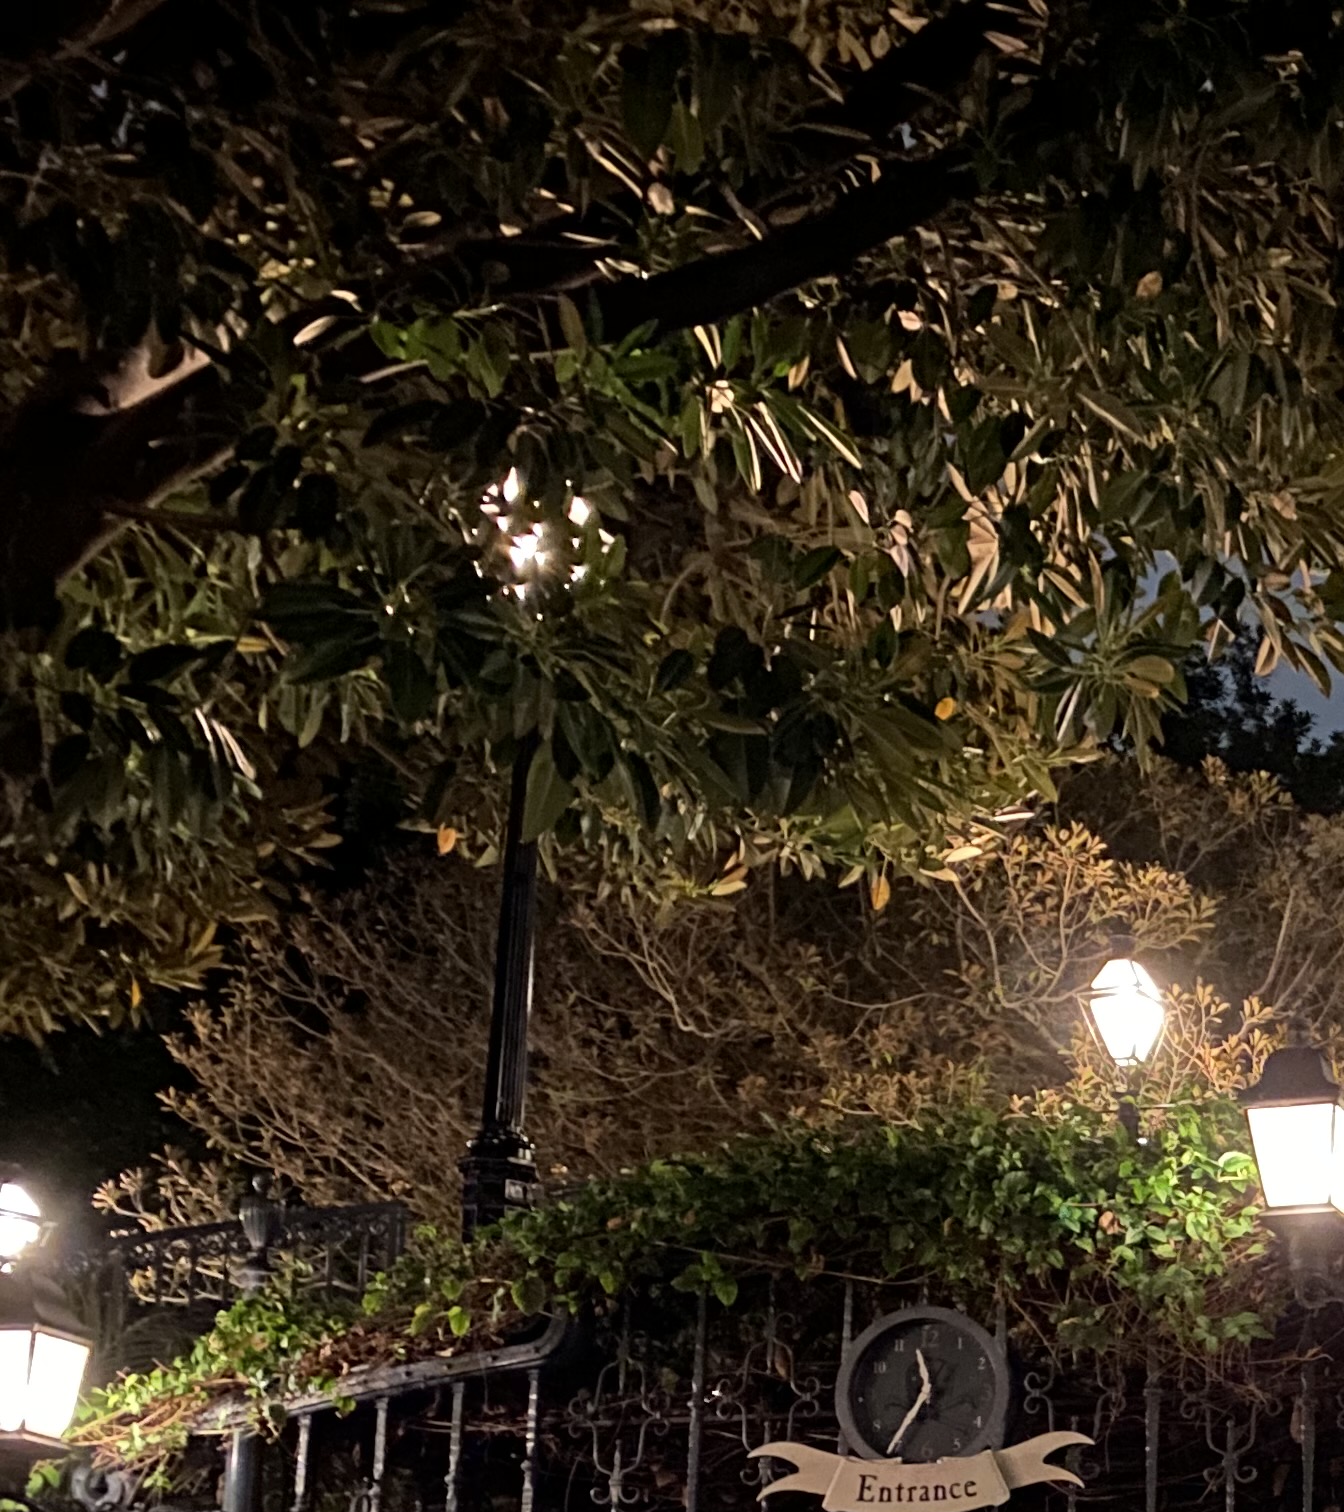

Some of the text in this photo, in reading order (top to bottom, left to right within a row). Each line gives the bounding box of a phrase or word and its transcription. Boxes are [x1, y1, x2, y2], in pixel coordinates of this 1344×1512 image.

[894, 1338, 905, 1352] 11
[921, 1329, 939, 1348] 12
[873, 1361, 887, 1374] 10
[977, 1356, 986, 1370] 2
[872, 1418, 881, 1432] 8
[973, 1415, 982, 1429] 4
[952, 1438, 961, 1450] 5
[856, 1474, 978, 1503] Entrance
